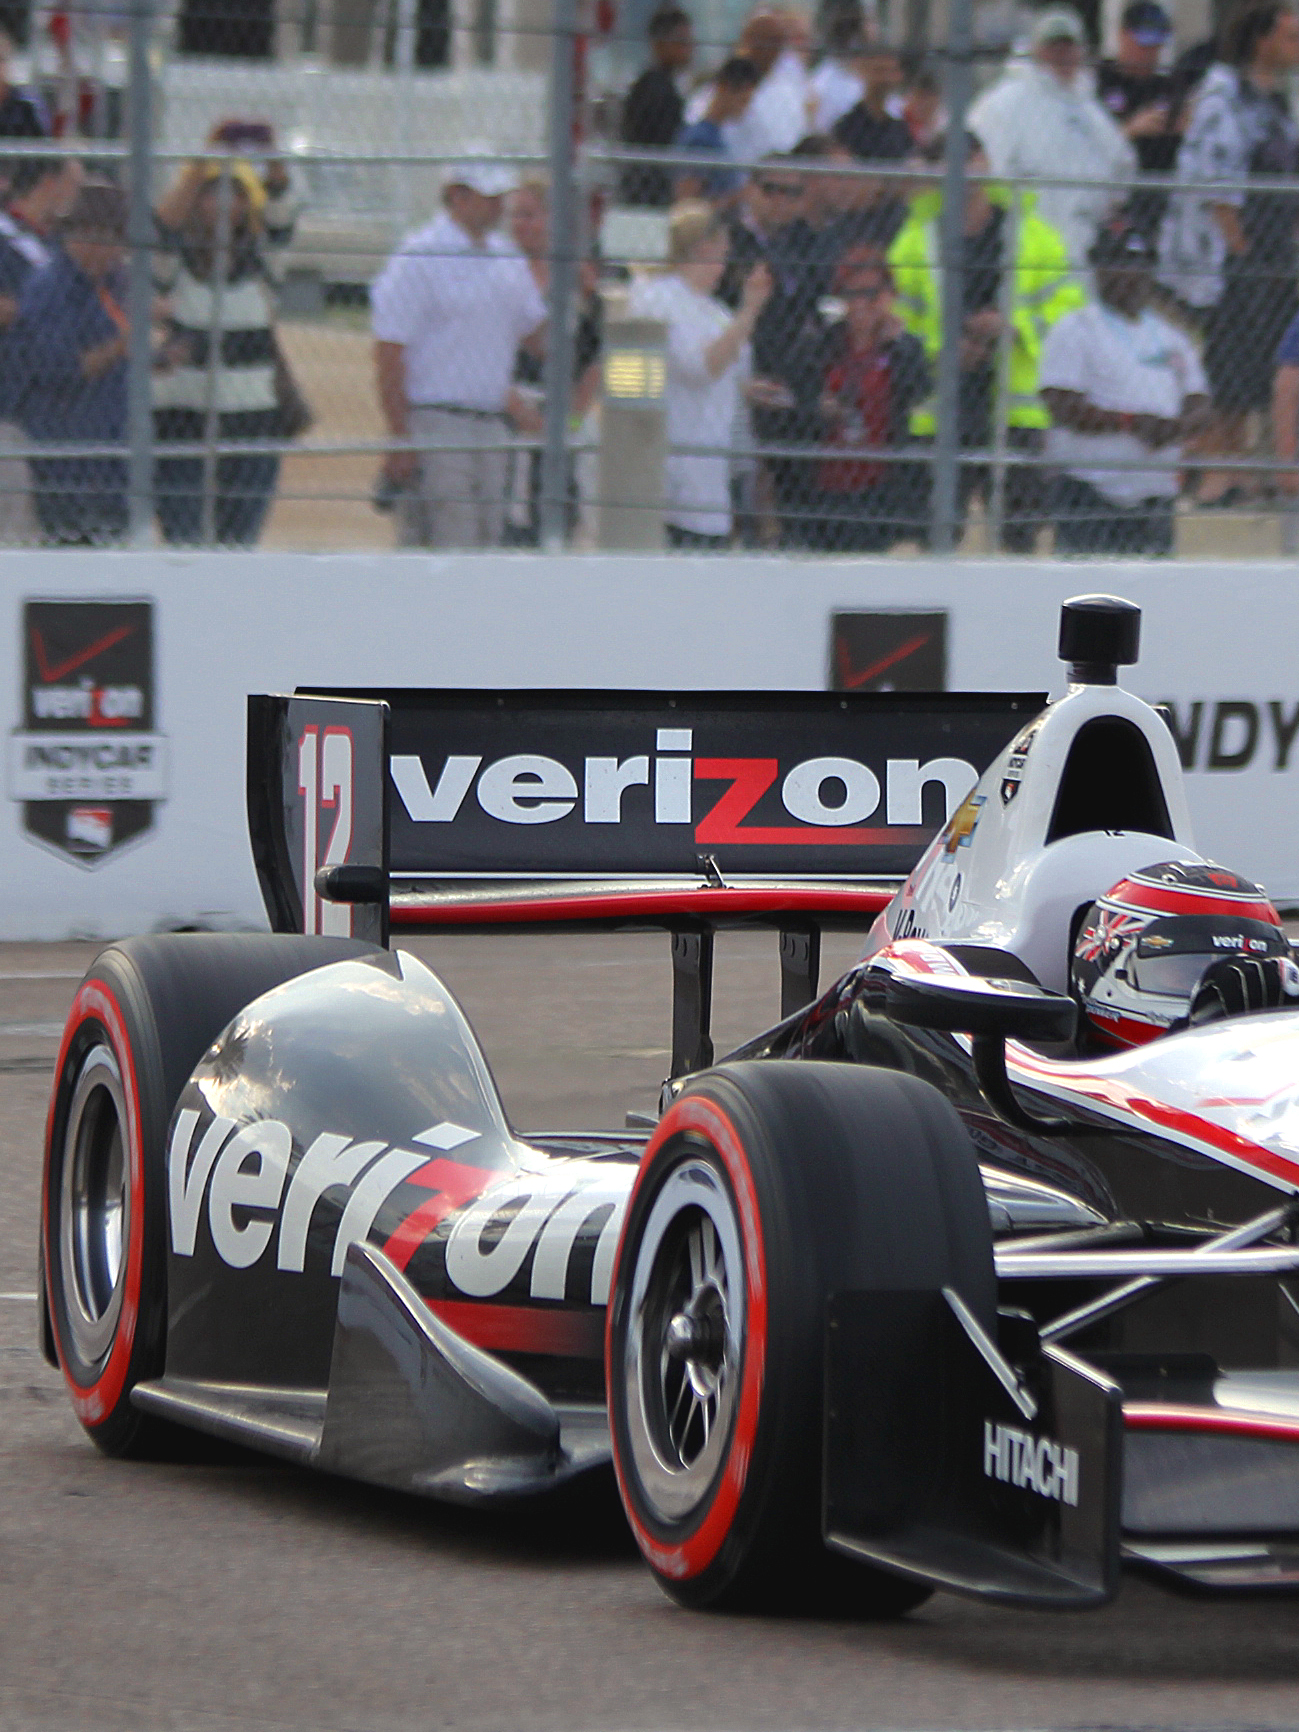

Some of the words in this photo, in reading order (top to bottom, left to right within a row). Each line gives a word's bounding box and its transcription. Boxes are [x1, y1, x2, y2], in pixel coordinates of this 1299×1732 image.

[298, 724, 353, 935] 12
[389, 728, 980, 845] verizon
[1212, 934, 1268, 953] verizon
[168, 1109, 637, 1305] verizon
[984, 1421, 1079, 1507] HITACHI
